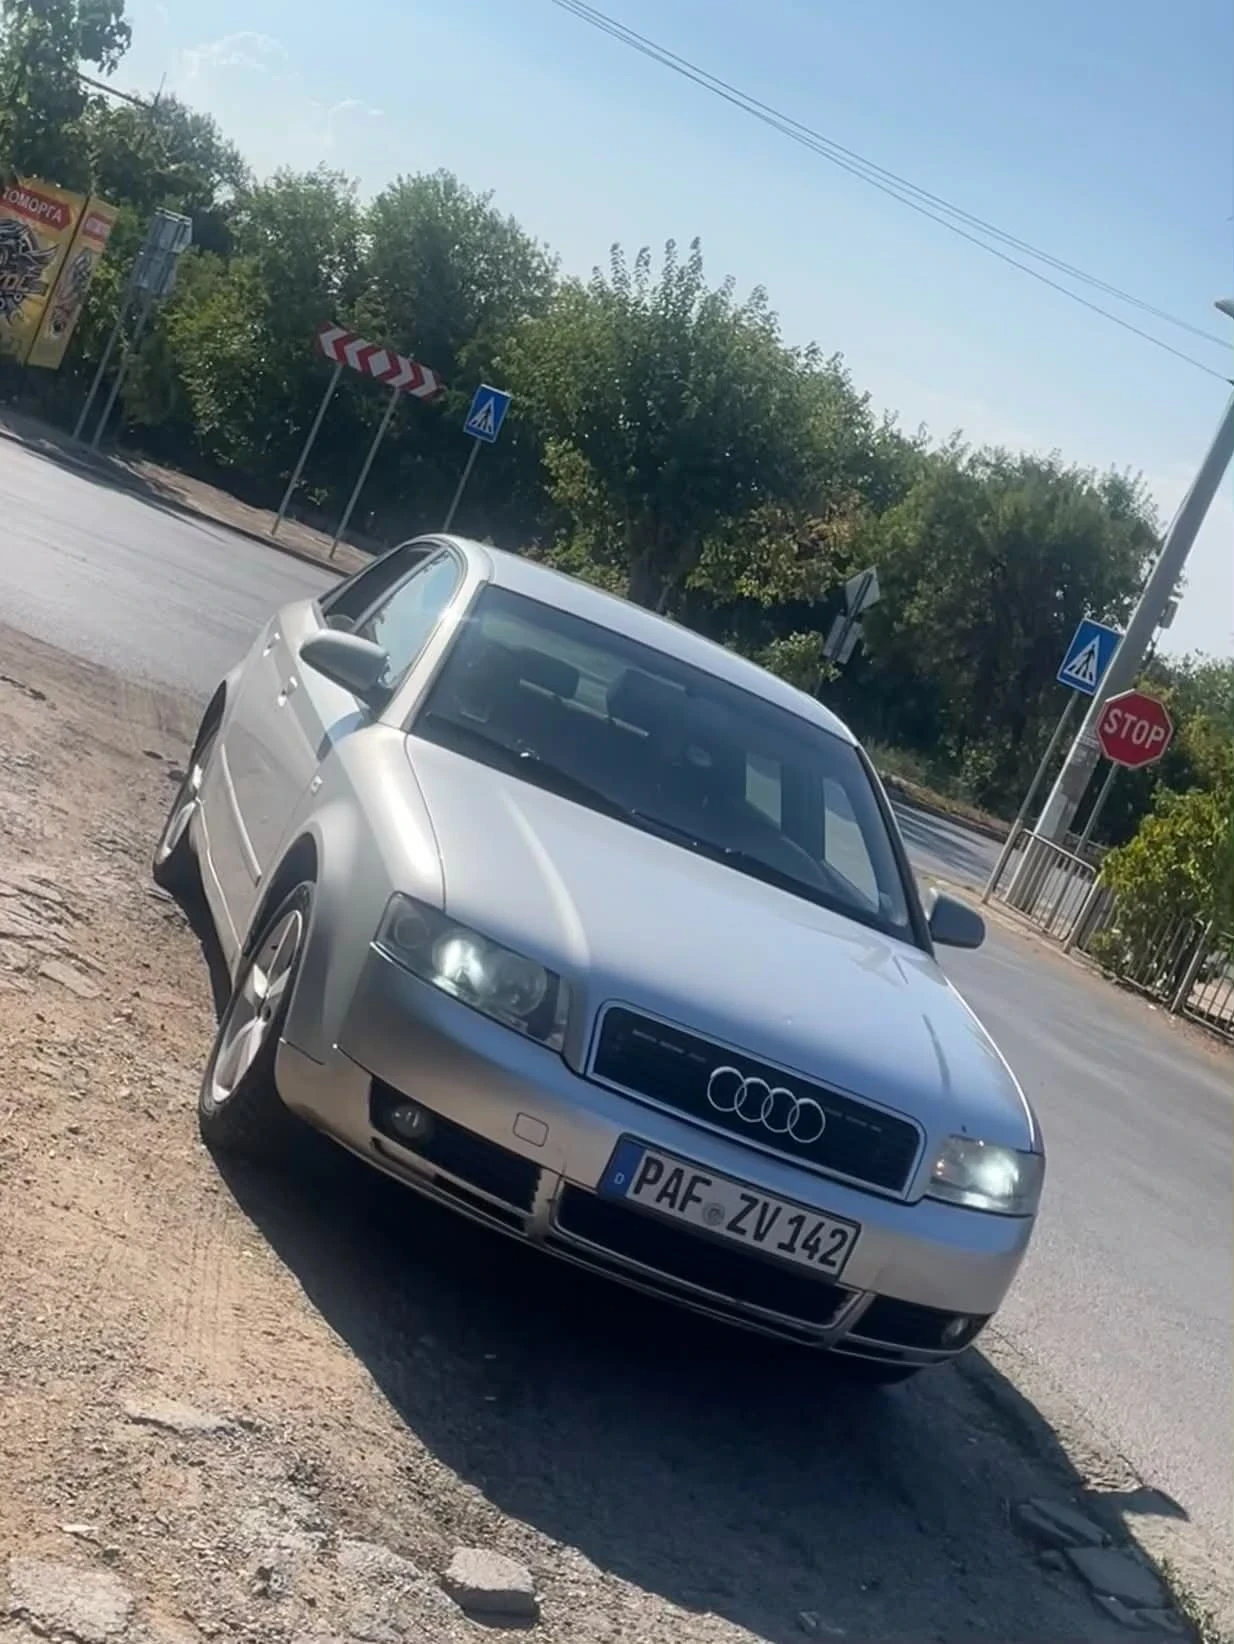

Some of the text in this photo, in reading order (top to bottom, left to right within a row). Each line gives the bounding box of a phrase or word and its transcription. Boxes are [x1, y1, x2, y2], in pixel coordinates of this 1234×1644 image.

[1103, 708, 1165, 749] STOP
[633, 1155, 848, 1268] PAF ZV 142
